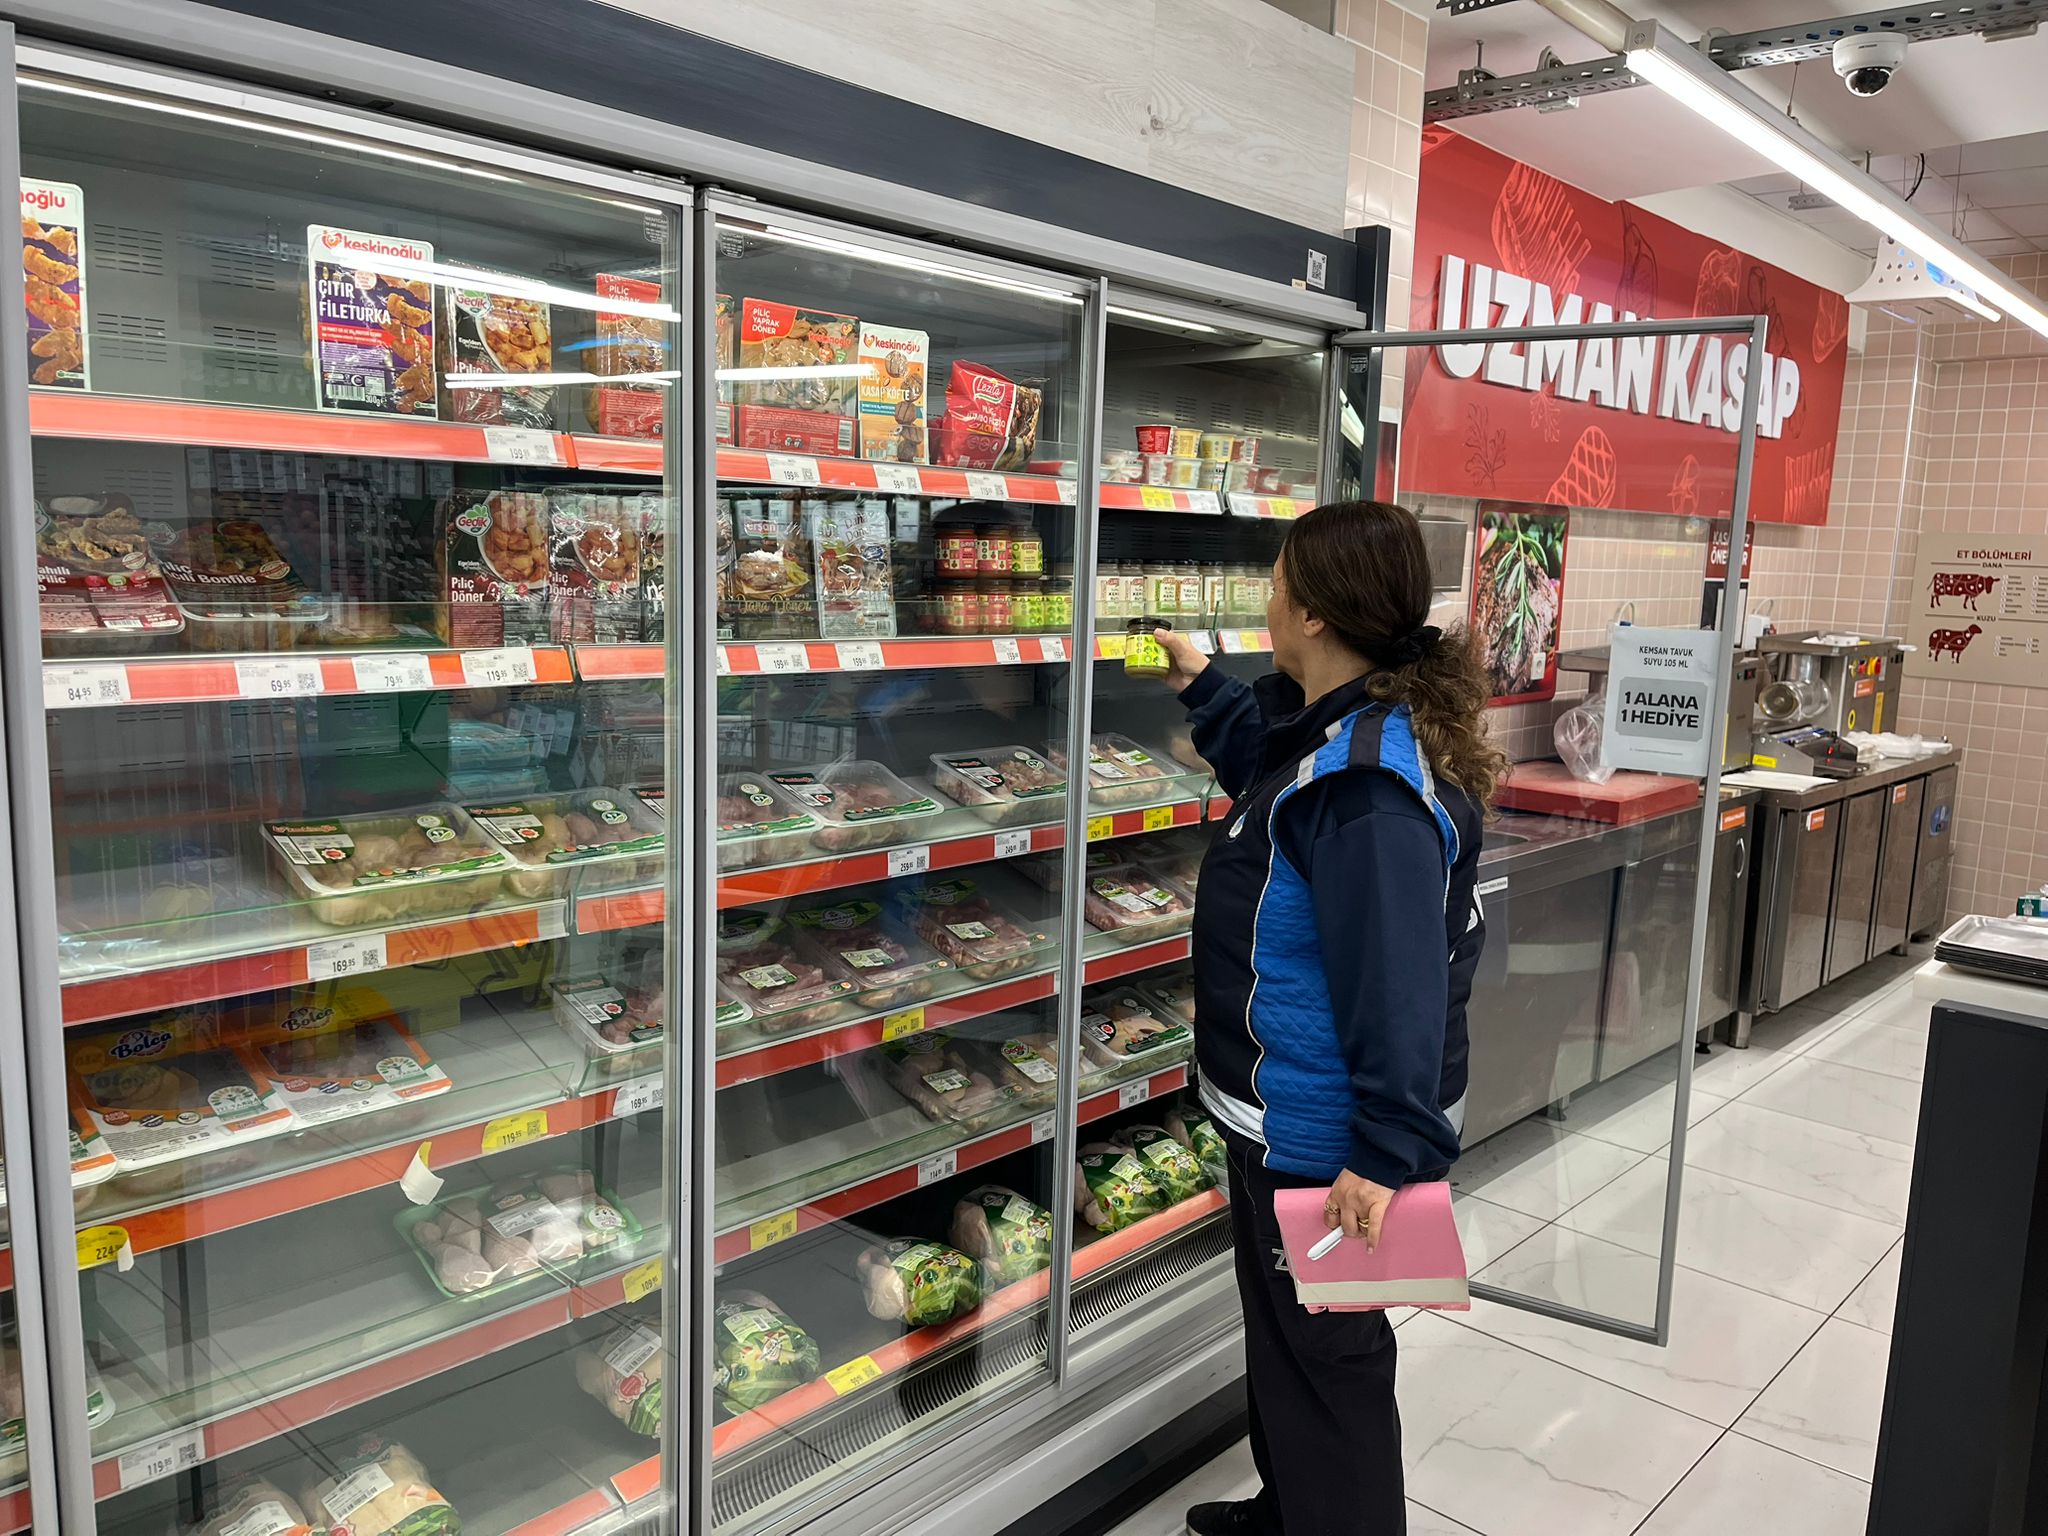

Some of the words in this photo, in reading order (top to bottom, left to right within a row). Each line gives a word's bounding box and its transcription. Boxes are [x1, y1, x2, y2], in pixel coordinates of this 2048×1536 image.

[20, 189, 66, 210] oğlu
[318, 279, 355, 299] ÇITIR
[319, 299, 392, 325] FİLETURKA
[752, 306, 771, 318] PİLİÇ
[751, 323, 777, 336] DÖNER
[752, 315, 780, 328] YAPRAK
[875, 336, 921, 354] keskinoğlu
[1438, 254, 1657, 415] UZMAN
[1655, 330, 1800, 439] KASAP
[976, 376, 1001, 399] Lezita
[458, 516, 487, 527] Gedik
[1957, 549, 1970, 559] ET
[1971, 549, 2032, 561] BÖLÜMLERİ
[197, 574, 257, 585] Bonfile
[451, 576, 475, 591] Piliç
[451, 590, 485, 602] Döner
[1638, 645, 1669, 656] KEMSAN
[1670, 647, 1694, 657] TAVUK
[1643, 657, 1663, 667] SUYU
[1664, 659, 1677, 667] 105
[1677, 660, 1689, 668] ML
[1624, 691, 1632, 704] 1
[1634, 691, 1699, 710] ALANA
[1621, 709, 1628, 722] 1
[1631, 709, 1700, 728] HEDİYE
[282, 1006, 336, 1032] Bolca
[110, 1030, 173, 1059] Bolca
